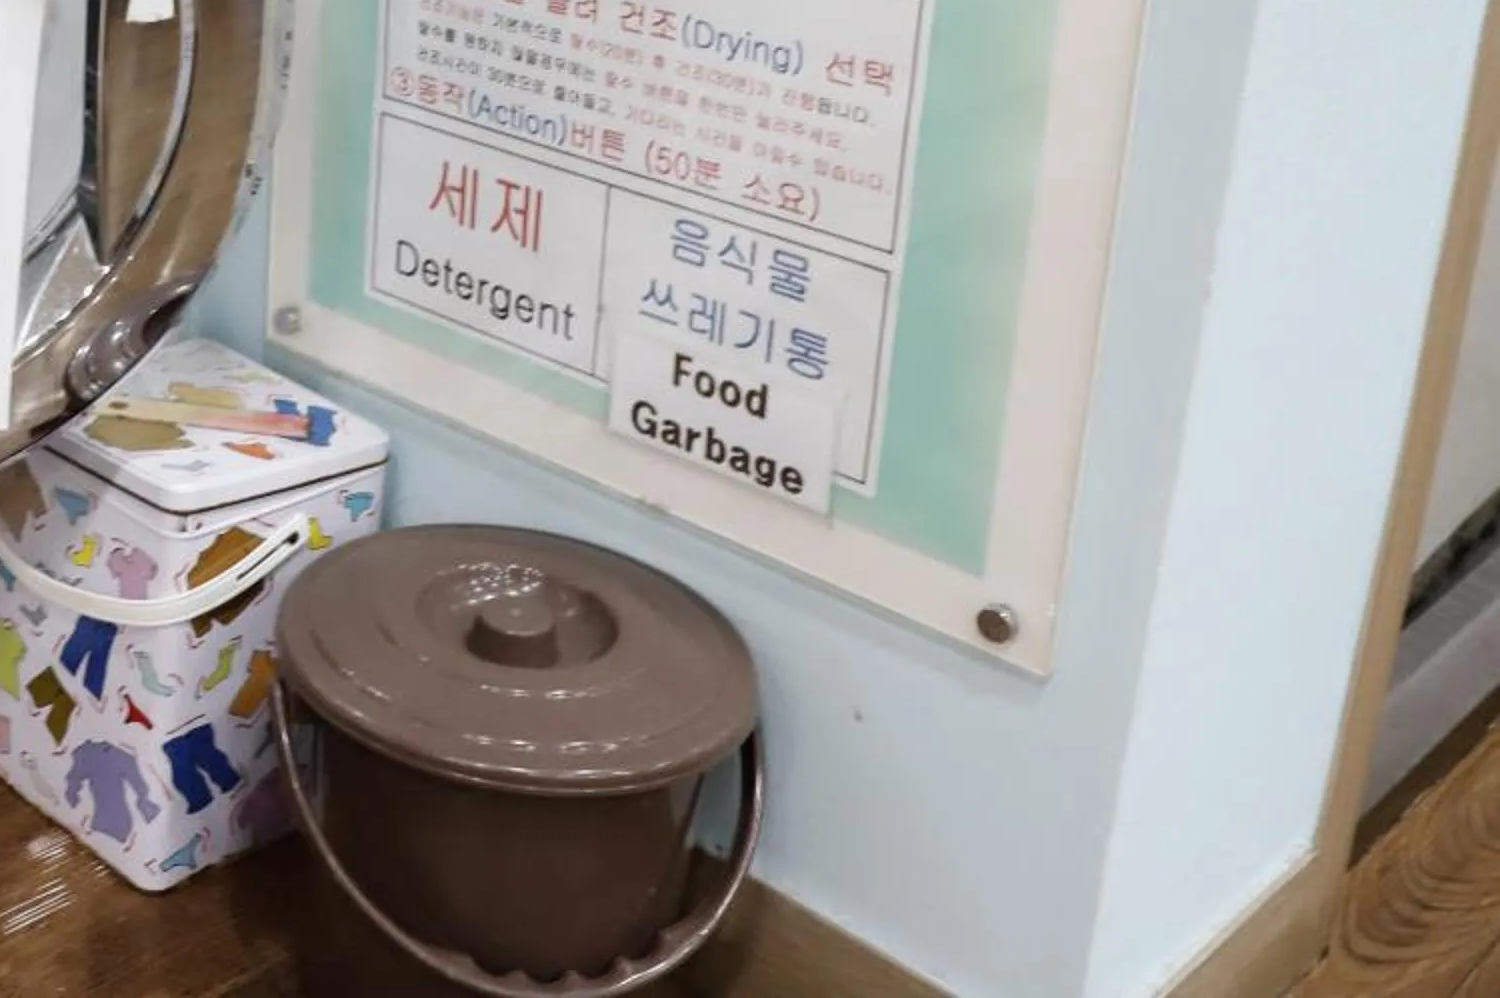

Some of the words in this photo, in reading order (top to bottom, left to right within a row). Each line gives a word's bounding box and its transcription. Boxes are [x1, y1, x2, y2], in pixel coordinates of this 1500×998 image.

[619, 0, 804, 76] 건조(Drying)
[824, 51, 896, 98] 선택
[428, 161, 544, 253] 세제
[645, 141, 722, 191] (50분
[741, 179, 821, 222] 소요)
[394, 239, 576, 340] Detergent
[670, 217, 812, 302] 음식물
[639, 278, 829, 381] 쓰레기통
[672, 352, 769, 419] Food
[631, 400, 805, 495] Garbage
